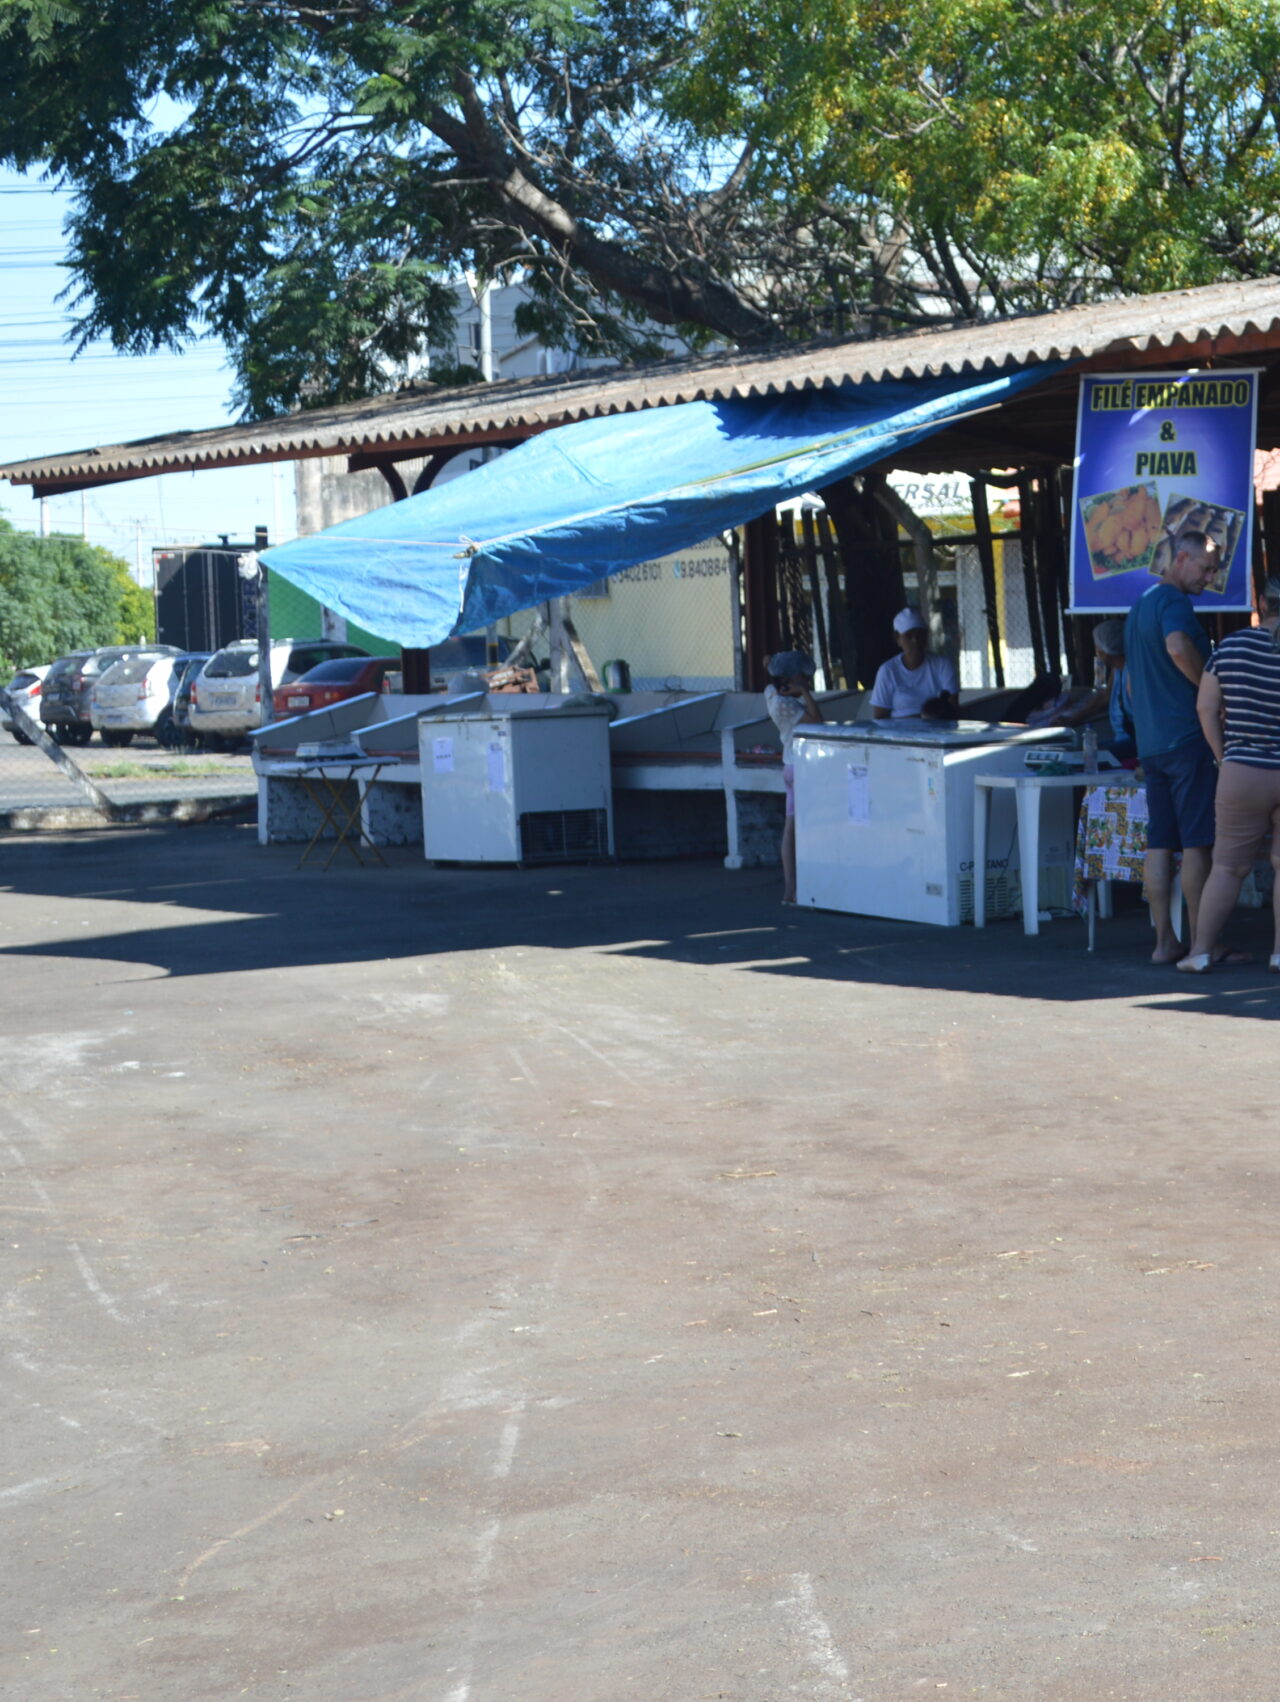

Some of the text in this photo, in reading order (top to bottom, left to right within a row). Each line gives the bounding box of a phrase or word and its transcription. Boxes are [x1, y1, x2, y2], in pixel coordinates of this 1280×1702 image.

[1091, 380, 1249, 411] FILÉ EMPANADO
[1159, 420, 1176, 442] &
[1135, 451, 1197, 476] PIAVA
